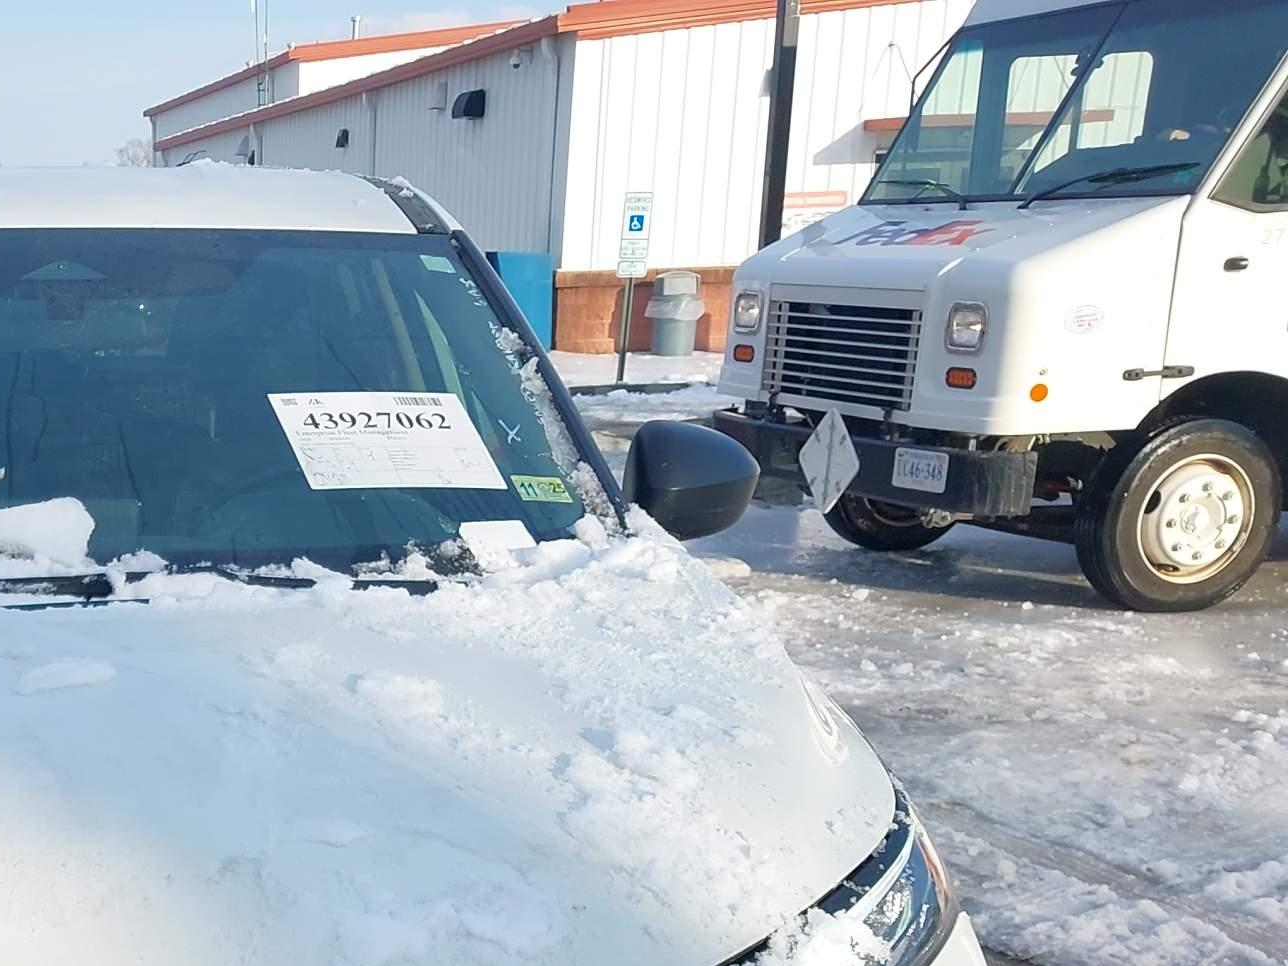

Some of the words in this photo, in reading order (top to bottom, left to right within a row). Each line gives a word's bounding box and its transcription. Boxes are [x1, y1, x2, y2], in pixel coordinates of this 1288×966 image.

[832, 220, 996, 246] FedEx
[303, 411, 452, 430] 43927062
[520, 482, 538, 497] 11
[549, 482, 566, 494] 25
